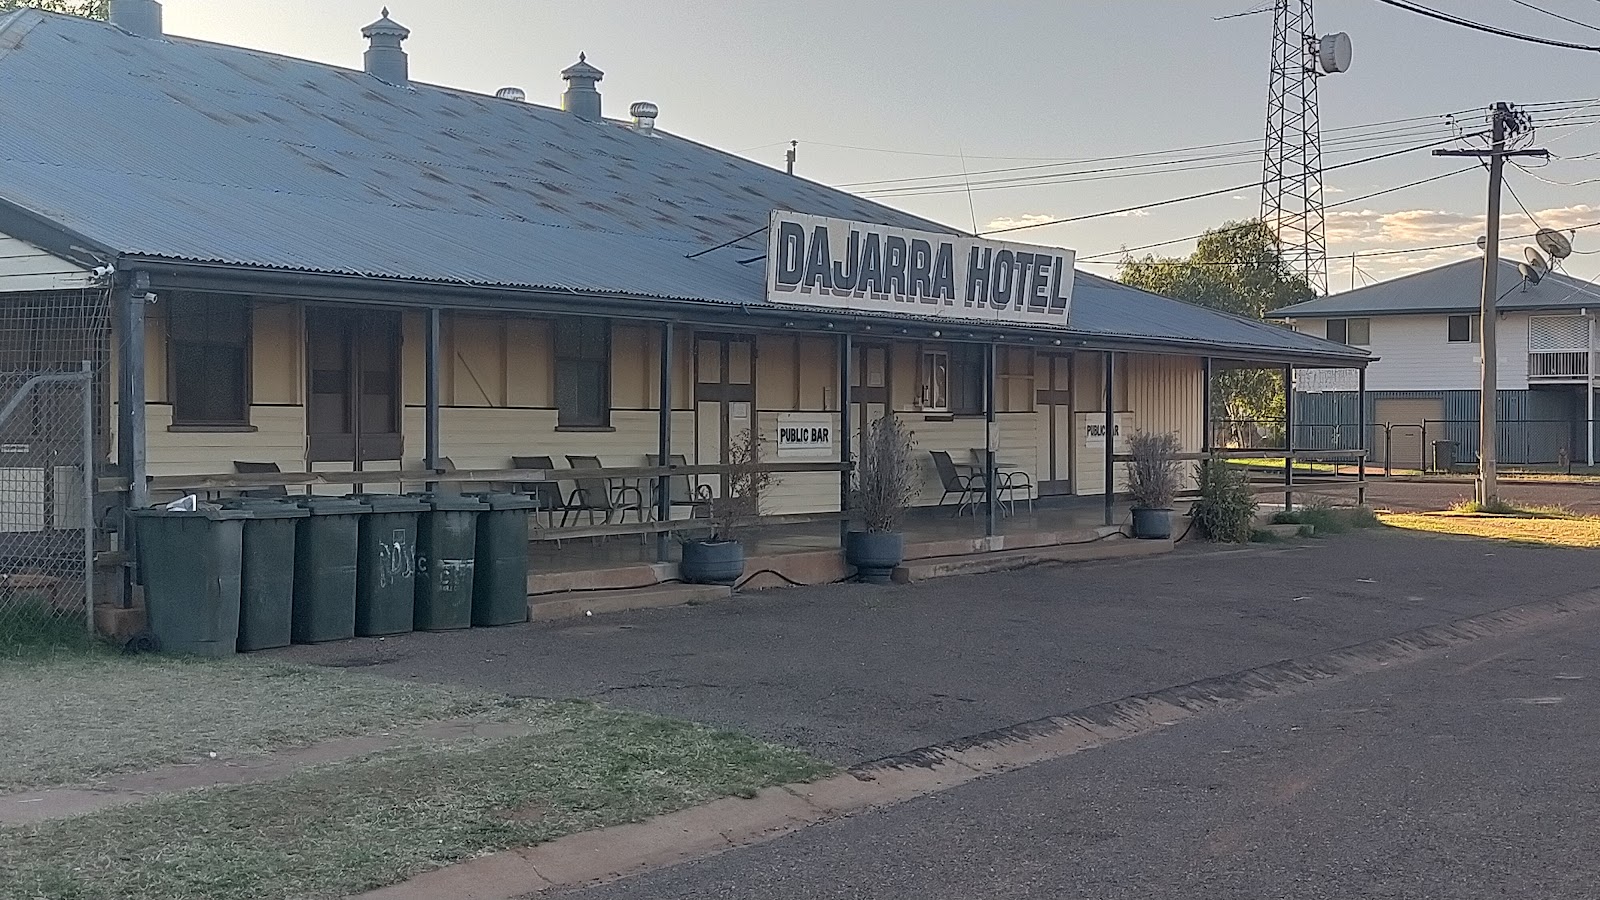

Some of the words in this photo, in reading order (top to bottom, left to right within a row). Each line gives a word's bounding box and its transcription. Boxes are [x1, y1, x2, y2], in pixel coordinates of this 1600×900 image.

[776, 221, 956, 304] DAJARRA
[965, 246, 1069, 315] HOTEL
[780, 427, 809, 443] PUBLIC
[811, 427, 829, 443] BAR
[1086, 424, 1106, 437] PUBLIC
